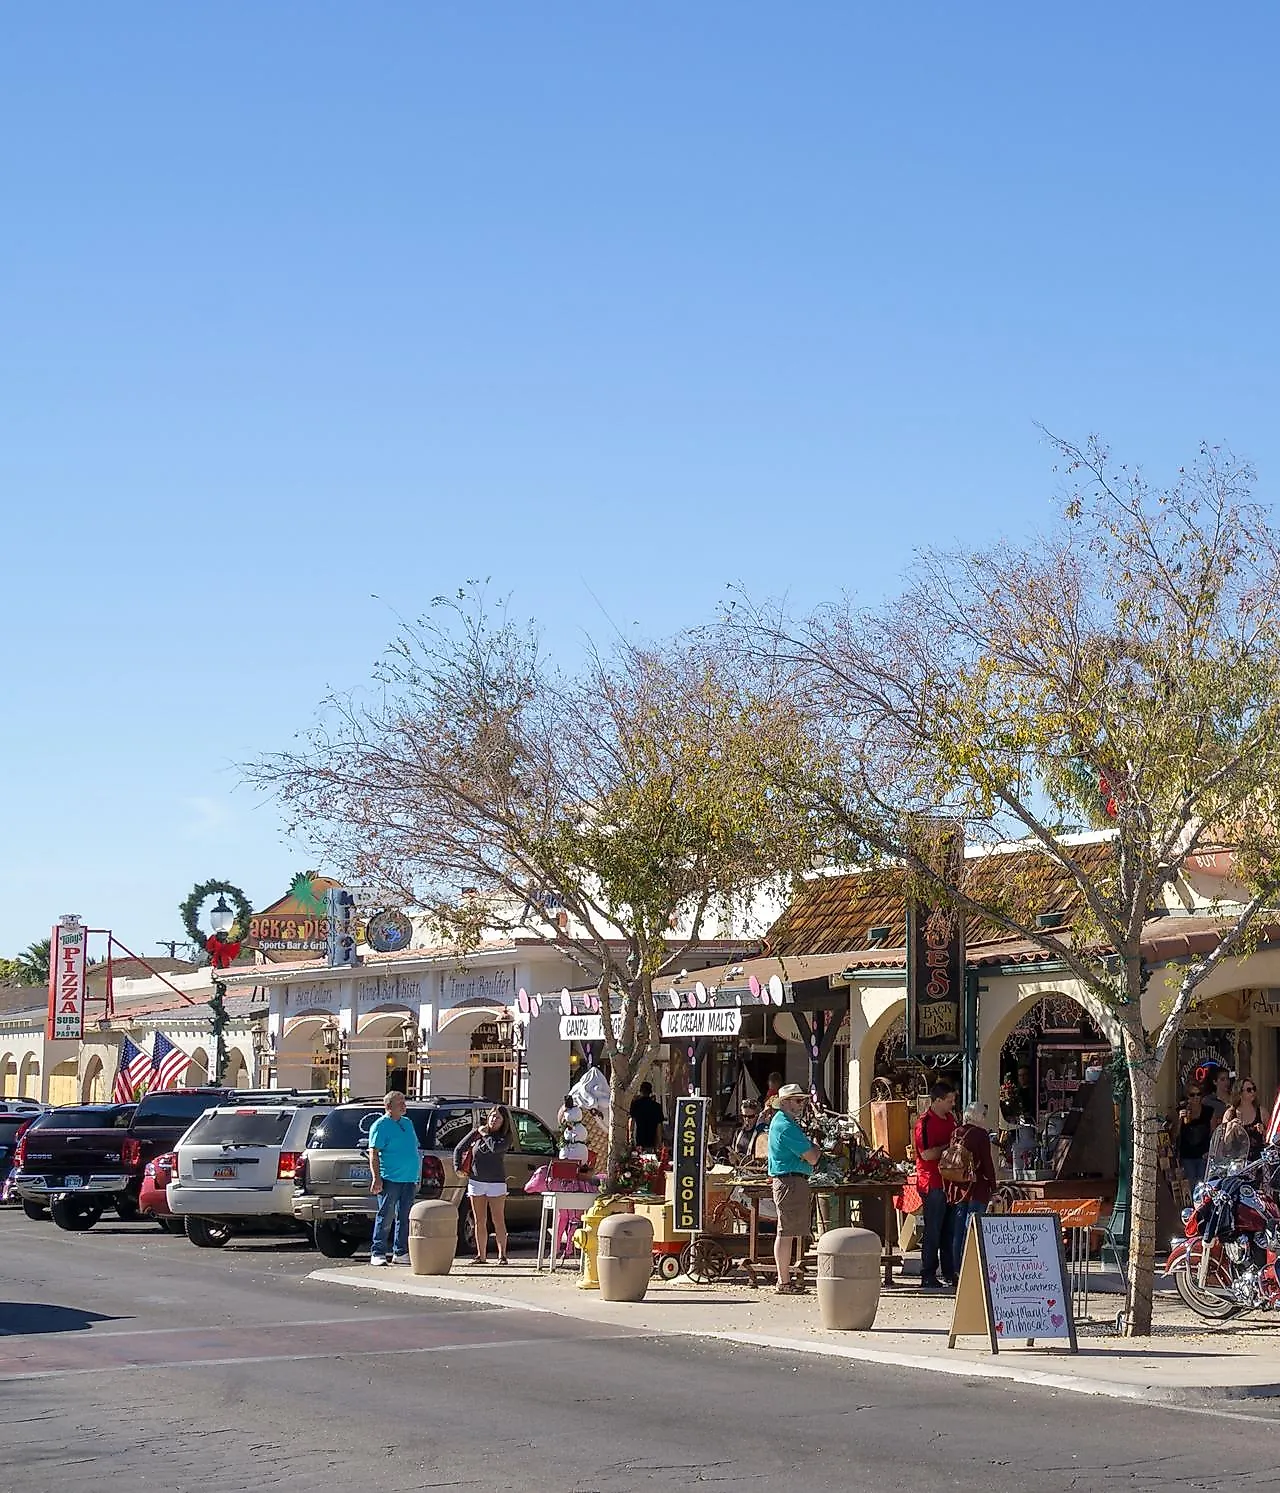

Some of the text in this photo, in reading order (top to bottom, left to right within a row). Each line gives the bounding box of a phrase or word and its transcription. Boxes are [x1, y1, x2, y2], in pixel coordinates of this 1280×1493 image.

[1195, 854, 1217, 868] BUY
[259, 940, 327, 951] Sports Bar & Grill
[59, 947, 81, 1014] PIZZA
[56, 1016, 81, 1025] SUBS
[566, 1018, 588, 1037] CANDY
[667, 1010, 736, 1034] ICE CREAM MALTS
[681, 1103, 697, 1227] CASH GOLD
[991, 1233, 1021, 1246] Coffee
